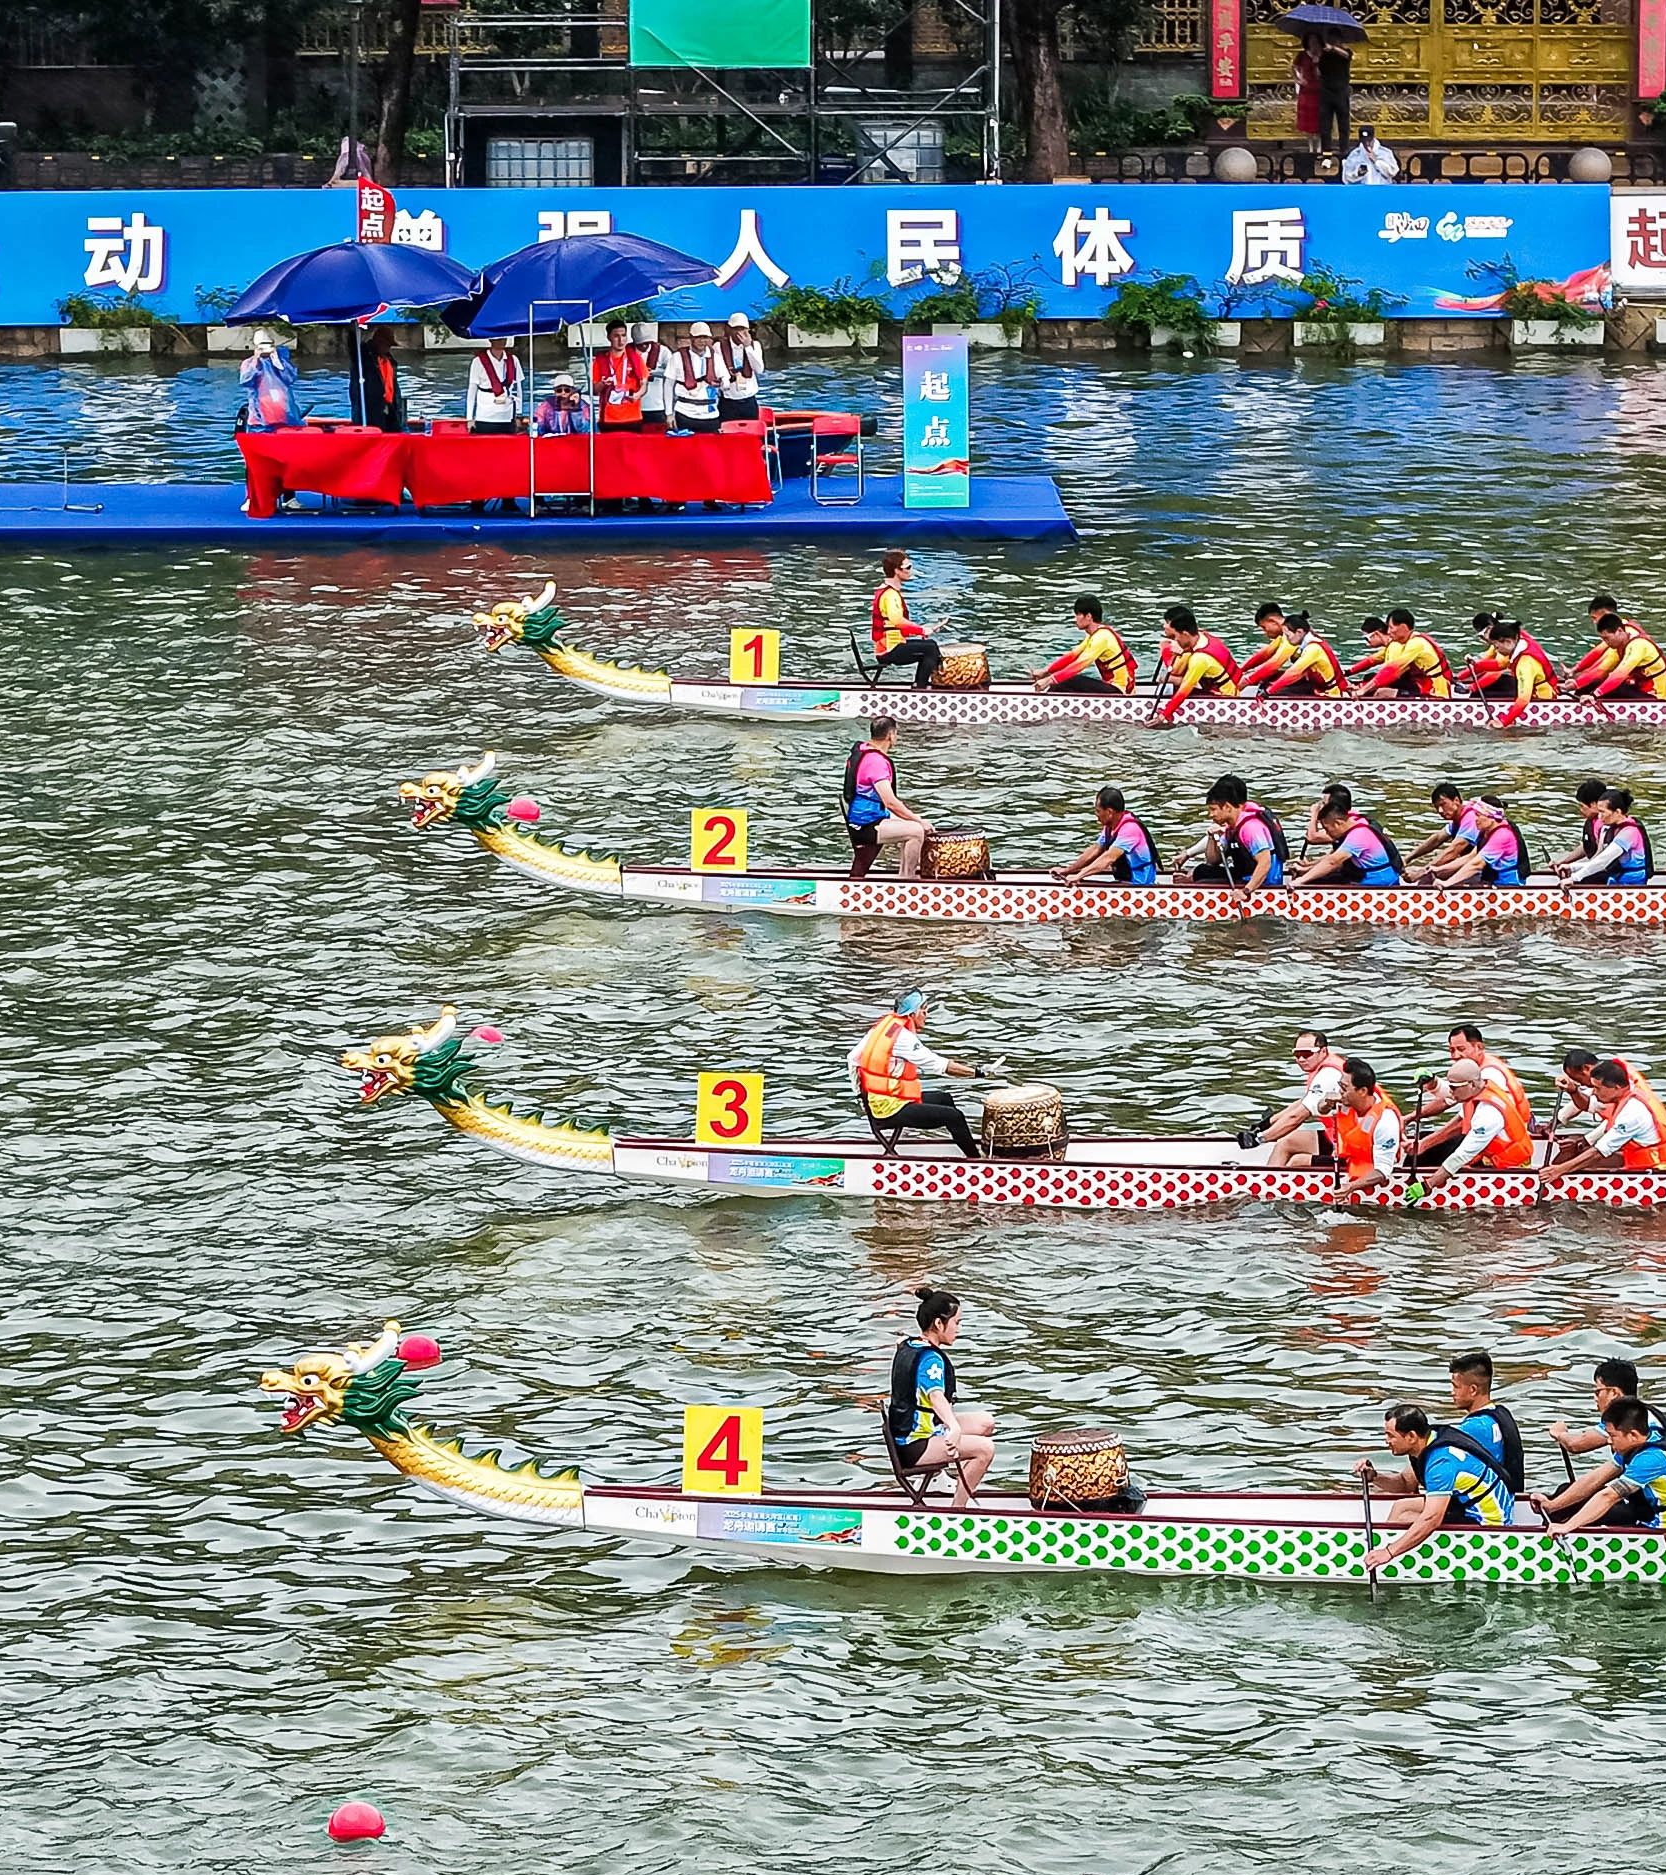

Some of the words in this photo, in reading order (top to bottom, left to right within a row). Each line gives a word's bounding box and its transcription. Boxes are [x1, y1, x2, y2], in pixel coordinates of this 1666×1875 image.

[360, 187, 385, 244] 起点
[919, 370, 951, 448] 起点
[743, 634, 763, 678] 1
[702, 816, 736, 865] 2
[709, 1080, 749, 1138] 3
[696, 1415, 748, 1486] 4
